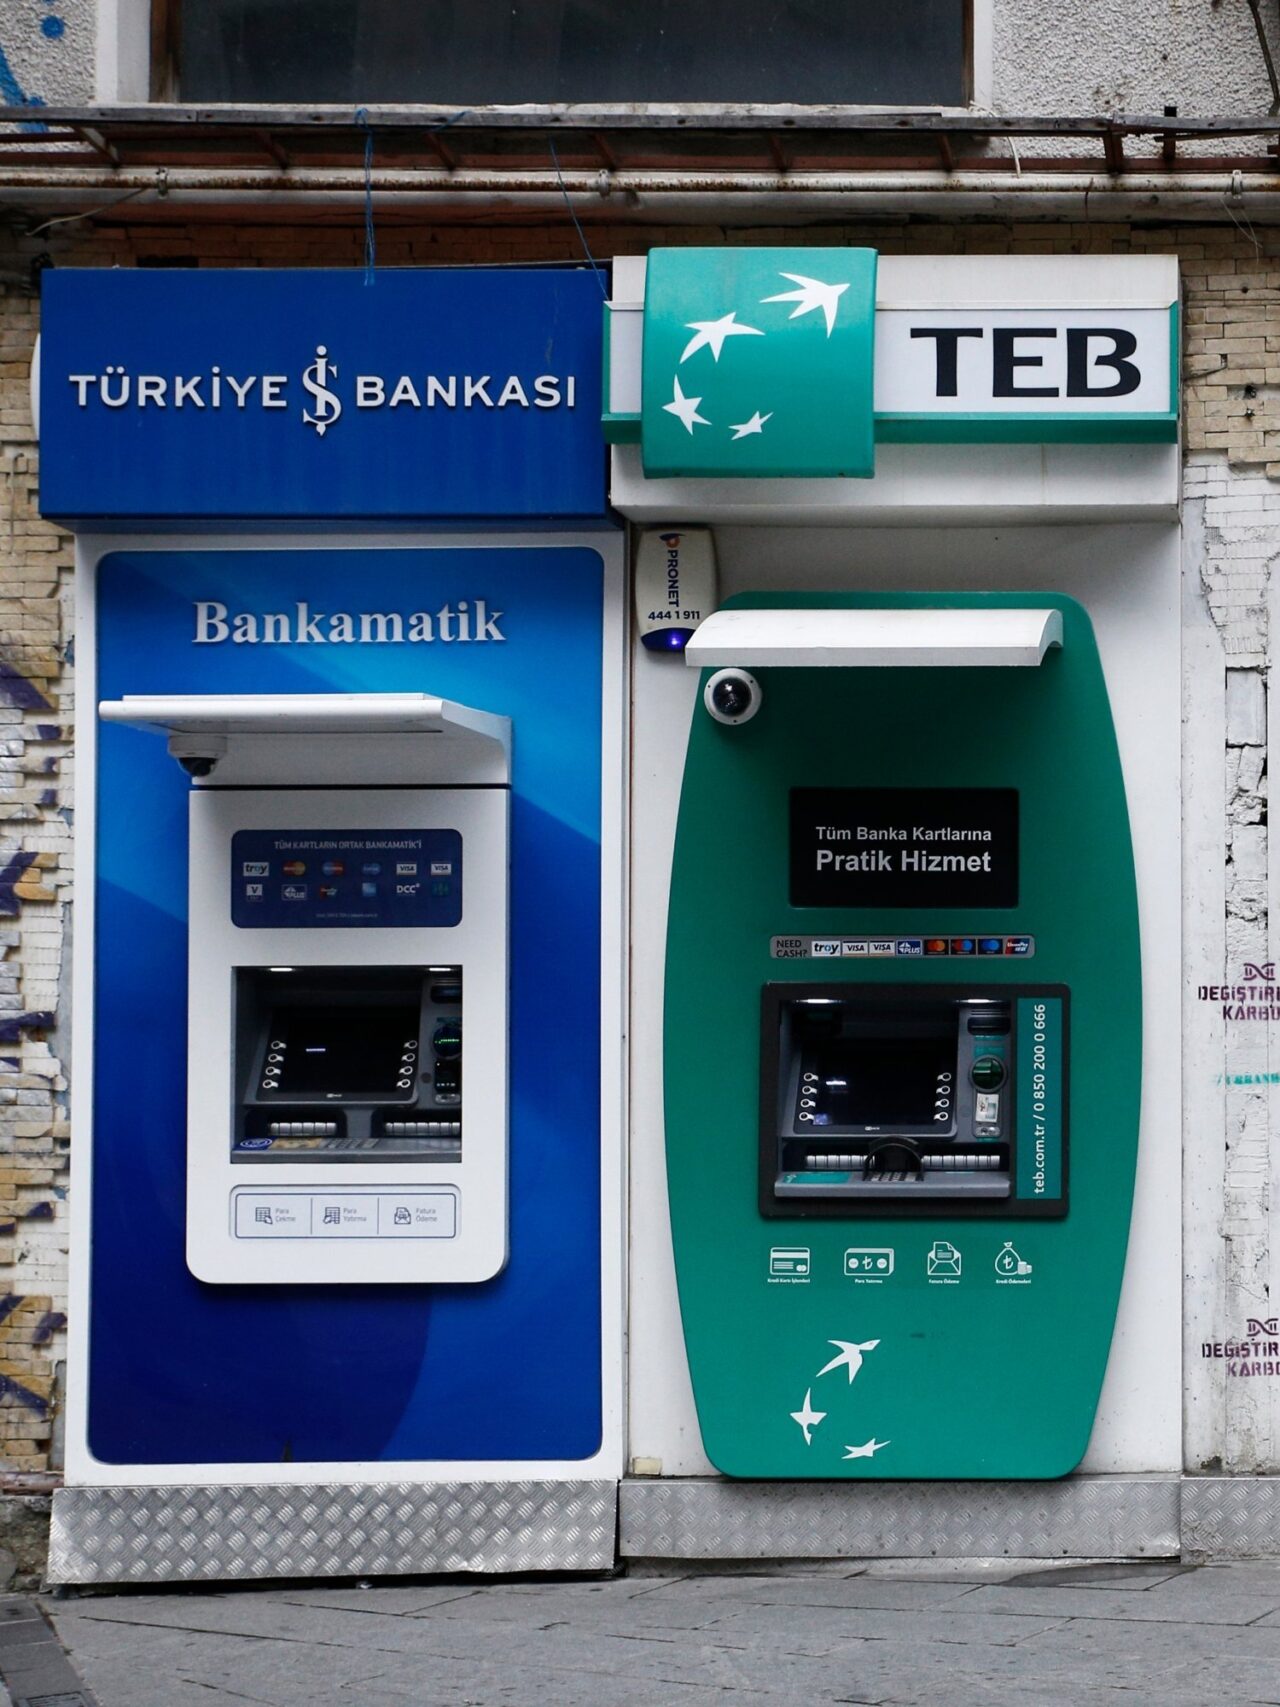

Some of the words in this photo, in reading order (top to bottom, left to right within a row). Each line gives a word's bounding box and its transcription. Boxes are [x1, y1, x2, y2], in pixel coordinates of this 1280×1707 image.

[910, 327, 1142, 398] TEB
[69, 366, 287, 407] TÜRKİYE
[356, 375, 575, 407] BANKASI
[668, 549, 679, 608] PRONET
[192, 600, 507, 644] Bankamatik
[648, 610, 672, 621] 444
[675, 610, 680, 619] 1
[683, 610, 701, 620] 911
[816, 826, 851, 841] Tüm
[856, 827, 908, 841] Banka
[912, 826, 992, 841] Kartlarına
[339, 841, 364, 850] ORTAK
[245, 863, 267, 875] troy
[816, 850, 892, 872] Pratik
[901, 850, 992, 872] Hizmet
[776, 939, 802, 949] NEED
[776, 948, 808, 958] CASH?
[813, 942, 840, 955] troy
[847, 943, 865, 952] VISA
[873, 942, 892, 951] VISA
[1033, 1004, 1045, 1031] 666
[1033, 1045, 1045, 1071] 200
[1033, 1073, 1045, 1100] 850
[1033, 1124, 1045, 1194] teb.com.tr
